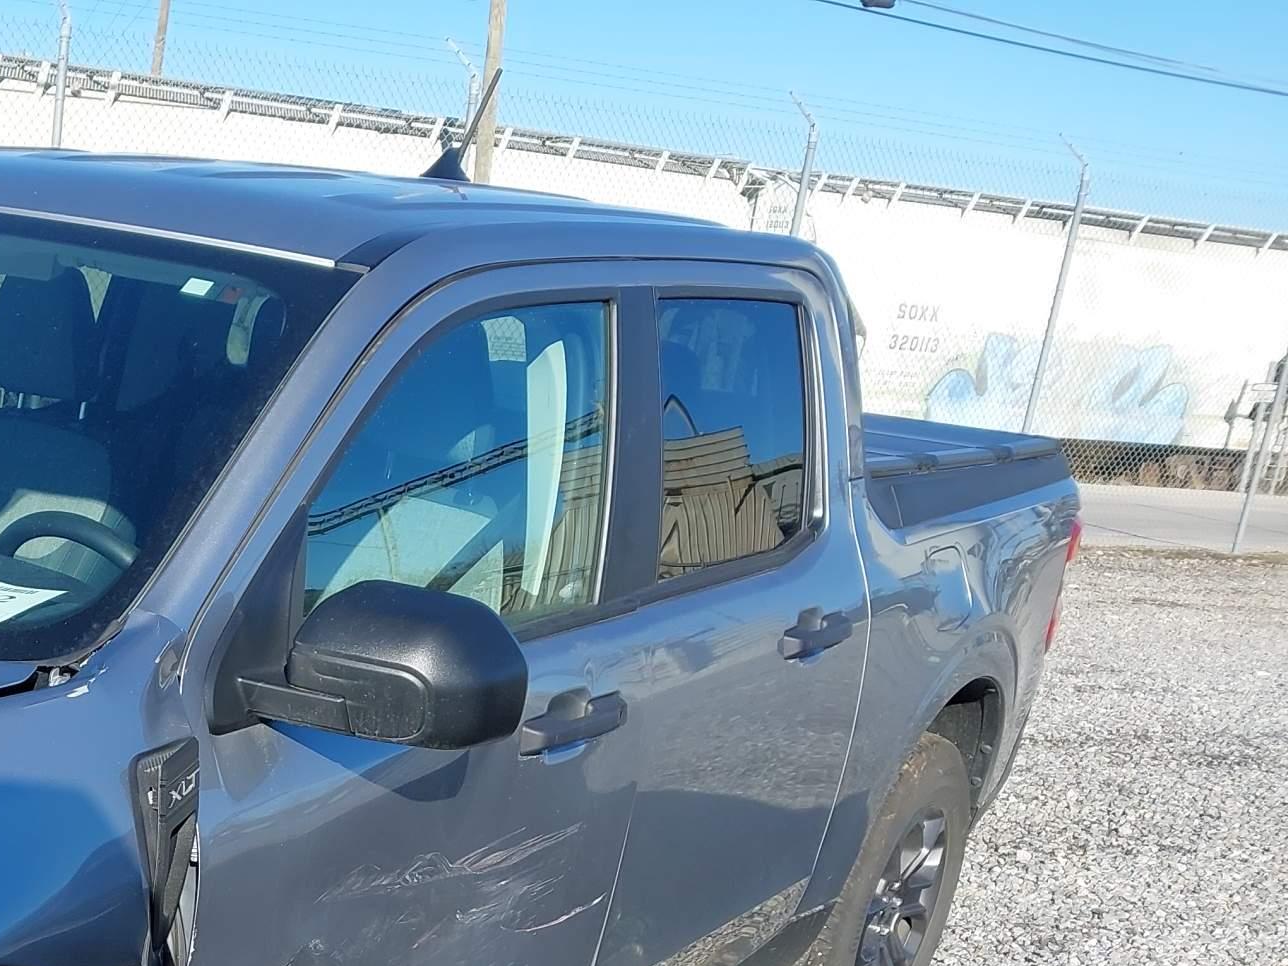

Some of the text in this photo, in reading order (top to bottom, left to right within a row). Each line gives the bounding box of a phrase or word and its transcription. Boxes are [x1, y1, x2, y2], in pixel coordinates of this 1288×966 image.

[896, 303, 940, 322] SOXX
[888, 334, 940, 353] 320113
[168, 768, 200, 809] XLT
